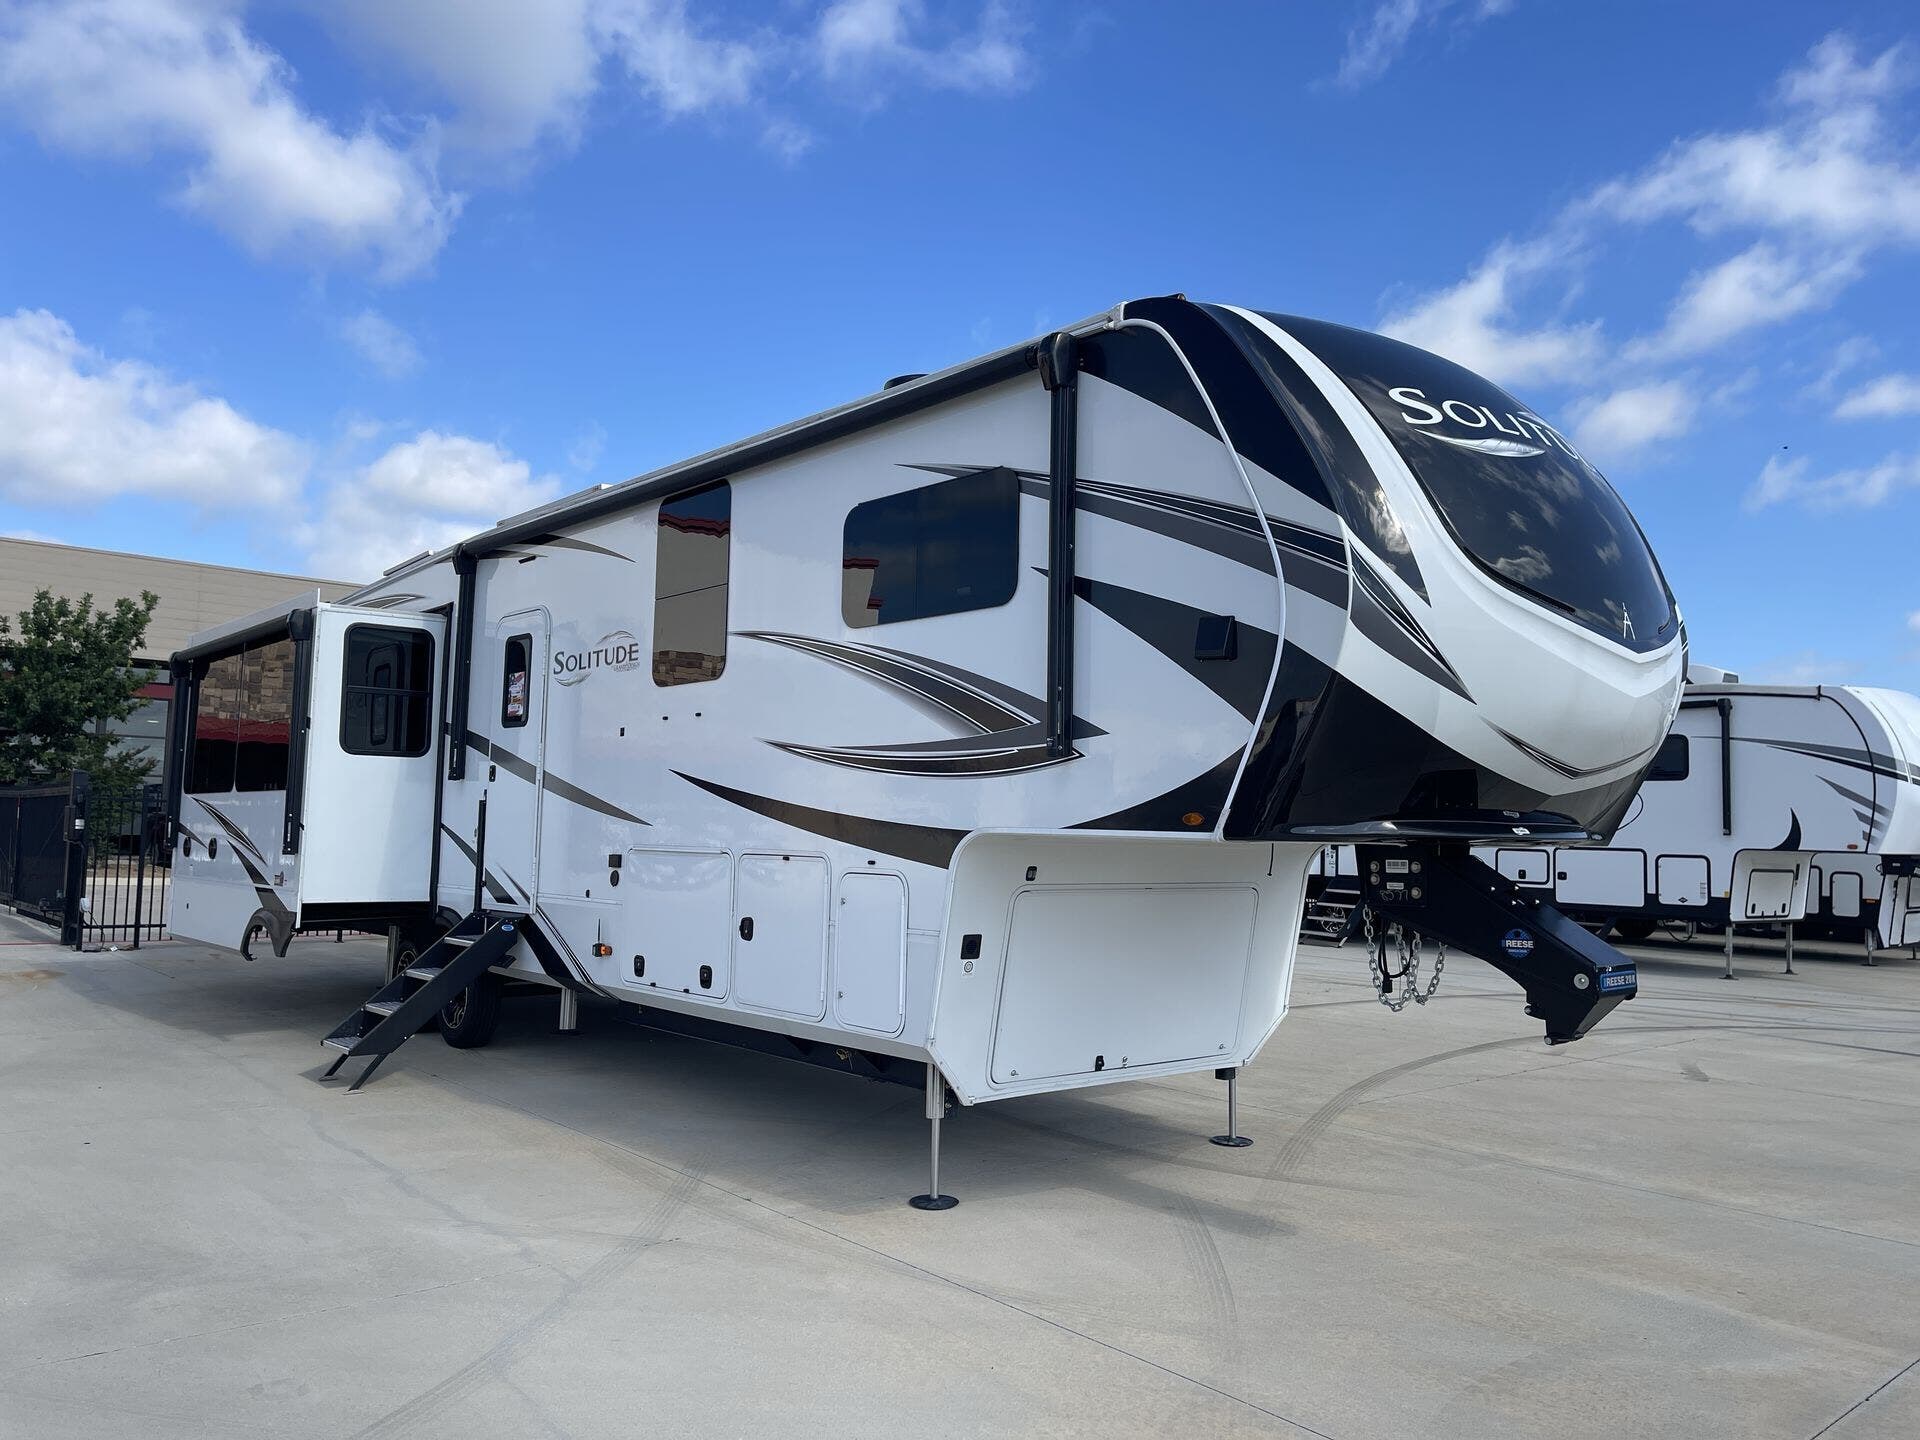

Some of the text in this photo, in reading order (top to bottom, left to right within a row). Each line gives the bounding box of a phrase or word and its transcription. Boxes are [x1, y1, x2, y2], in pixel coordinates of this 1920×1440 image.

[1388, 387, 1590, 467] SOLITU
[553, 643, 639, 675] SOLITUDE
[1505, 939, 1534, 949] REESE
[1606, 975, 1625, 987] REESE
